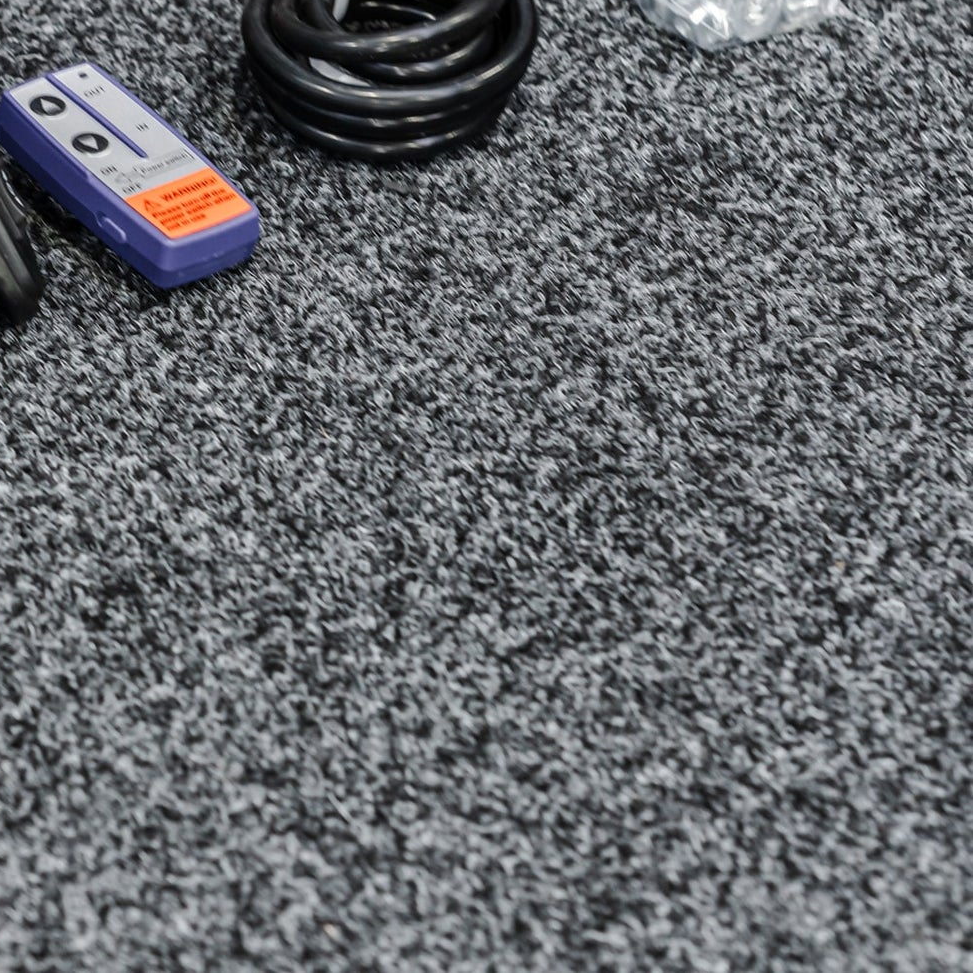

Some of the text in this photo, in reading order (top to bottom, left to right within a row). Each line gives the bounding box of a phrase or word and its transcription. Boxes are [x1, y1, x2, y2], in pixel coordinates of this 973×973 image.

[83, 85, 106, 98] OUT
[135, 122, 150, 132] IN
[122, 182, 142, 194] OFF
